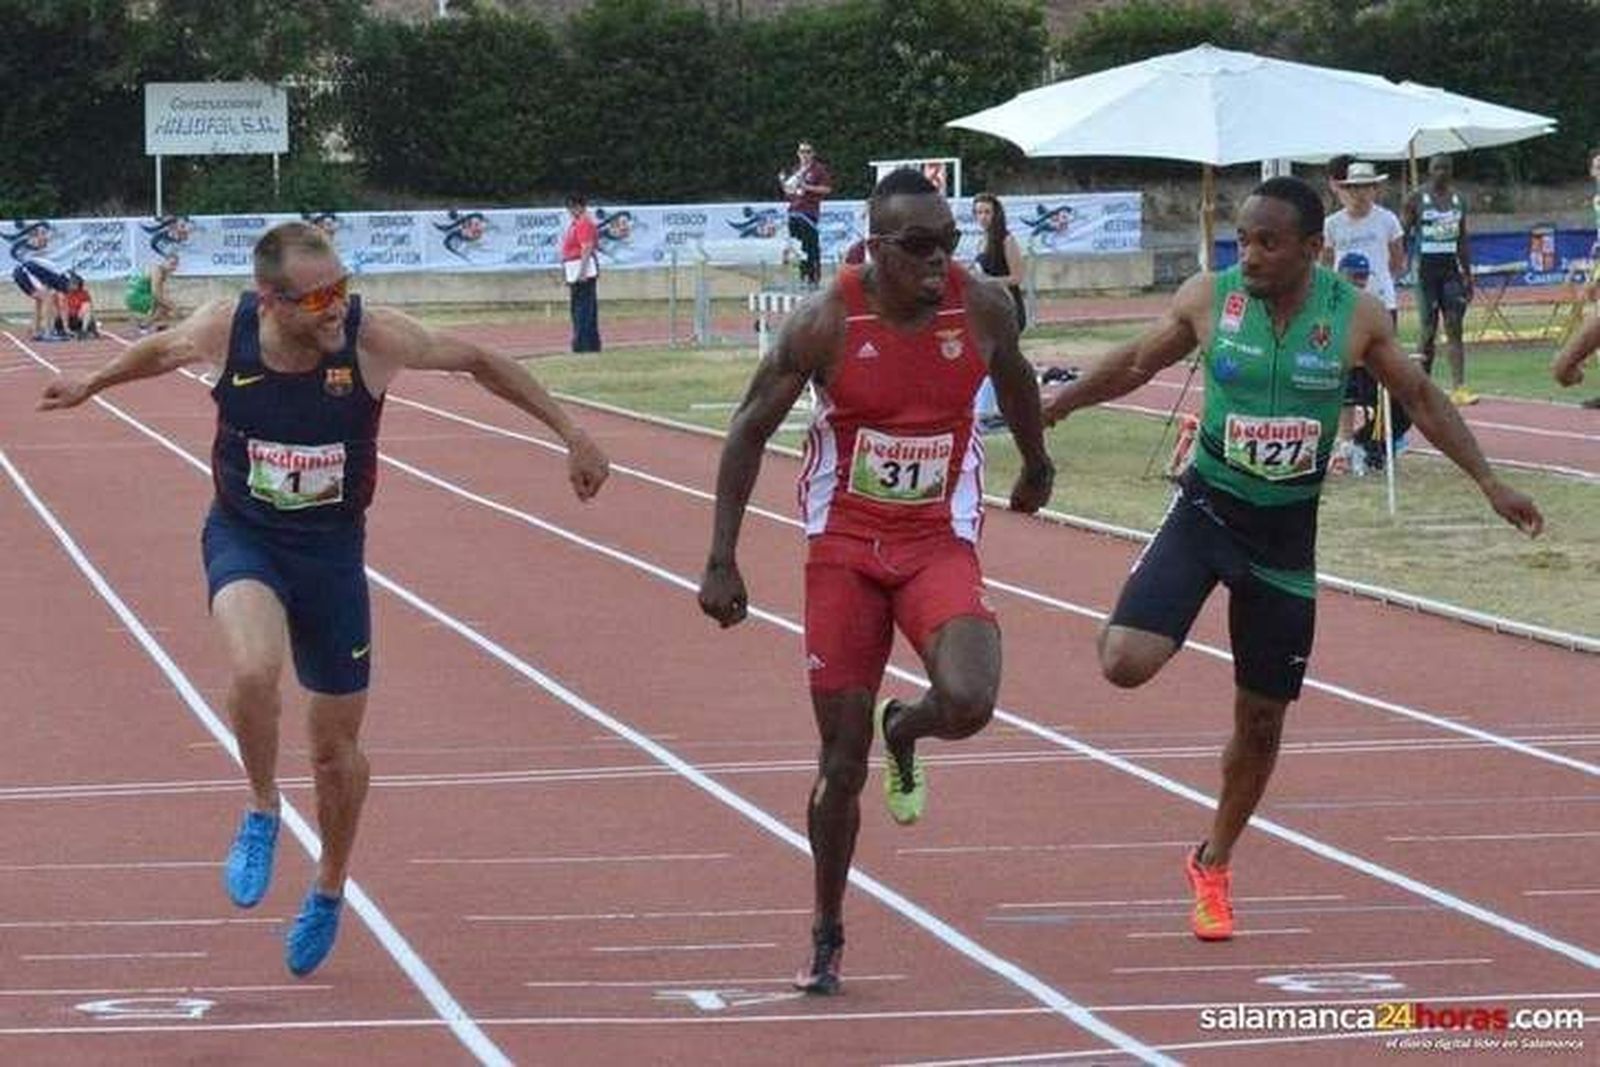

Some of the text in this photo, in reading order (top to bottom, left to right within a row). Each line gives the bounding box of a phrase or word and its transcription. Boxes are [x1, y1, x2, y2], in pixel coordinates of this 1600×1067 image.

[1246, 440, 1303, 466] 127
[287, 471, 301, 493] 1
[880, 461, 920, 489] 31
